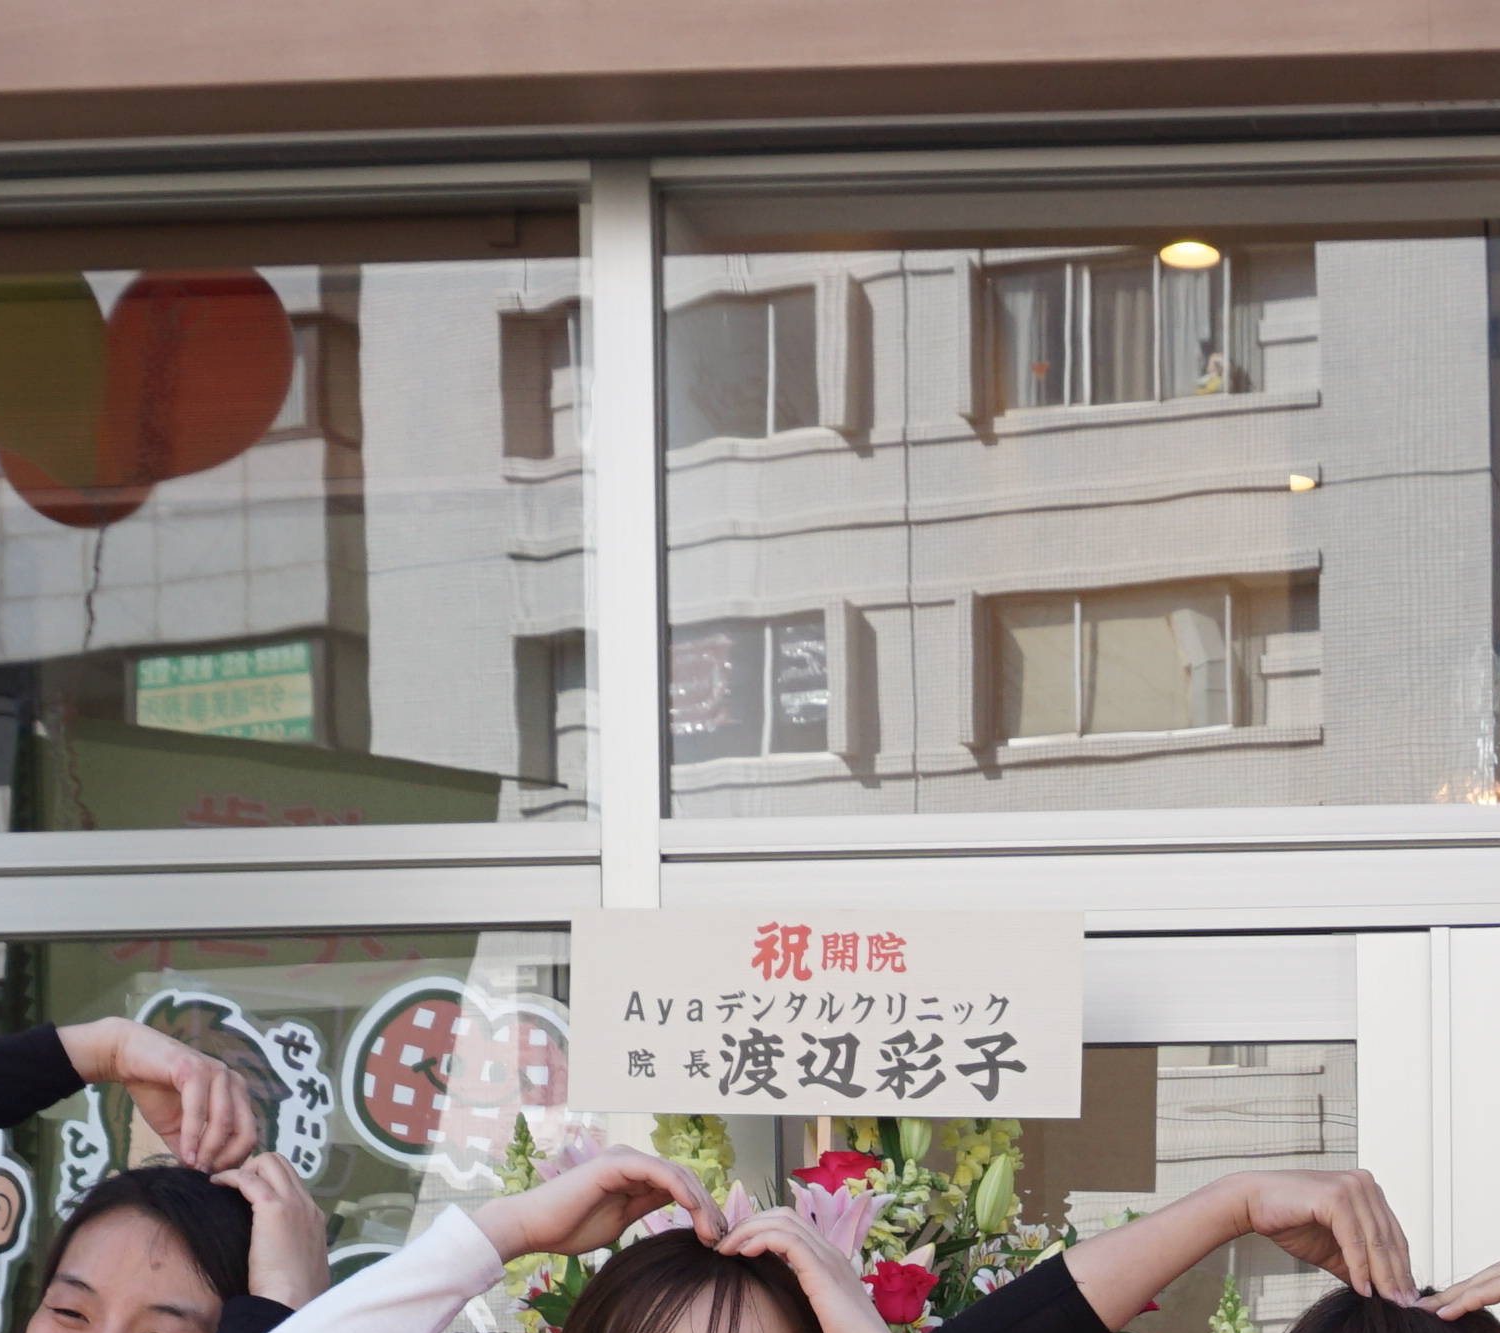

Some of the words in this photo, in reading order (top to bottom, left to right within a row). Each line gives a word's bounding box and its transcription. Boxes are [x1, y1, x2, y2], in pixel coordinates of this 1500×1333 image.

[624, 990, 1011, 1027] Ayaデンタルクリニック
[717, 1029, 1028, 1102] 渡辺彩子
